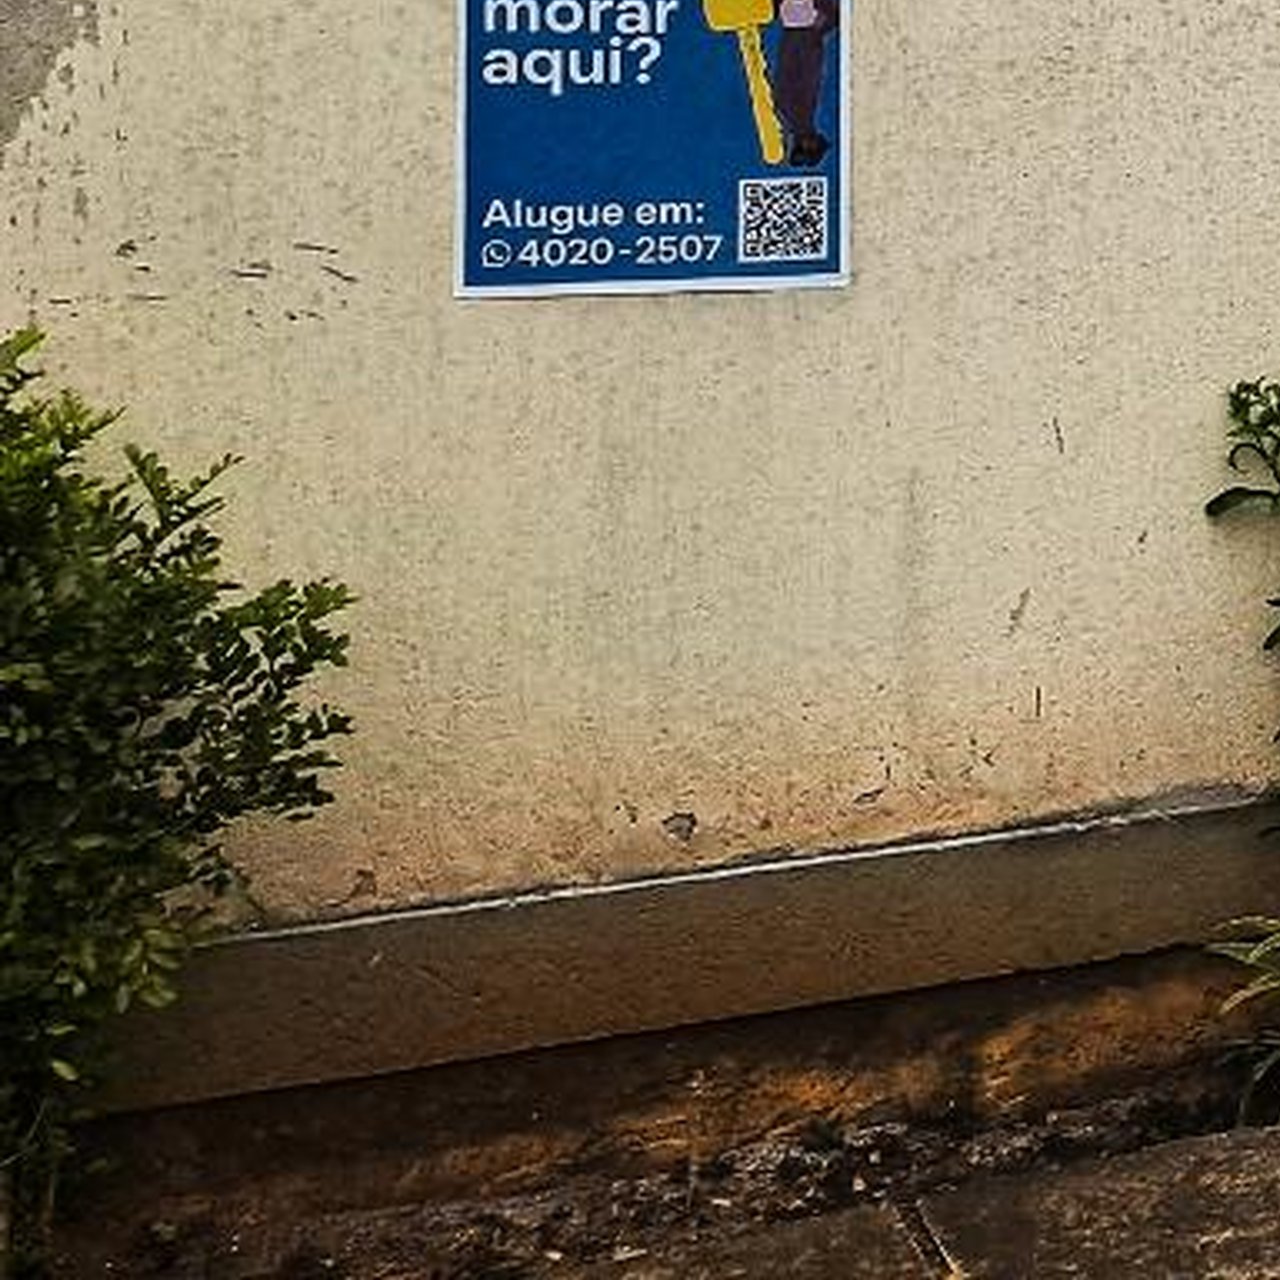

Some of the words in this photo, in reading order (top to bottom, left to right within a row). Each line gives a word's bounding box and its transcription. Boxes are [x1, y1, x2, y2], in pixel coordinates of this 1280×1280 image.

[482, 36, 662, 96] aqui?
[482, 198, 624, 235] Alugue
[634, 201, 705, 227] em:
